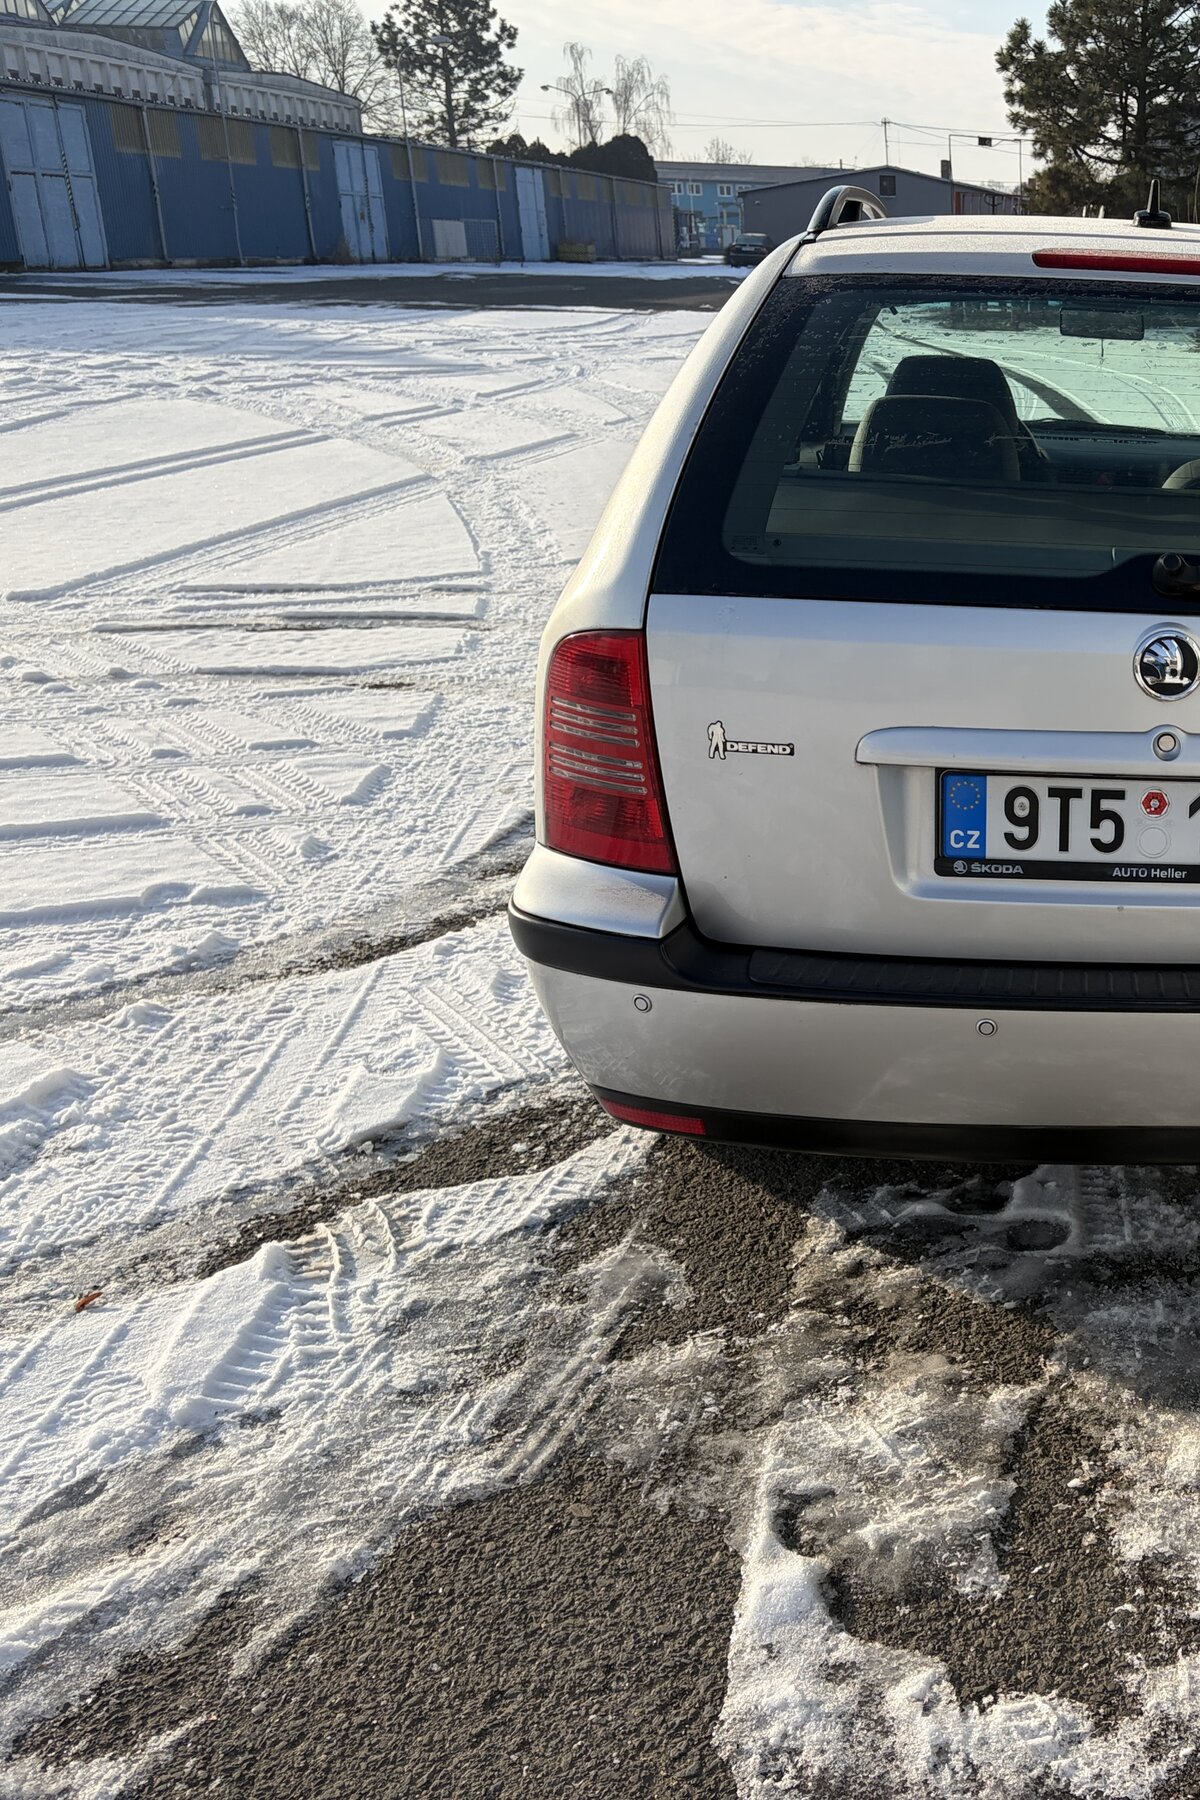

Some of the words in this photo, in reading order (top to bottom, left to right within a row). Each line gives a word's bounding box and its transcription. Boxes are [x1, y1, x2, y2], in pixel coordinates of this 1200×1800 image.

[726, 741, 791, 755] DEFEND
[1003, 785, 1126, 854] 9T5
[949, 829, 981, 850] CZ
[970, 861, 1024, 875] ŠKODA
[1112, 867, 1148, 878] AUTO
[1150, 867, 1188, 879] Heller
